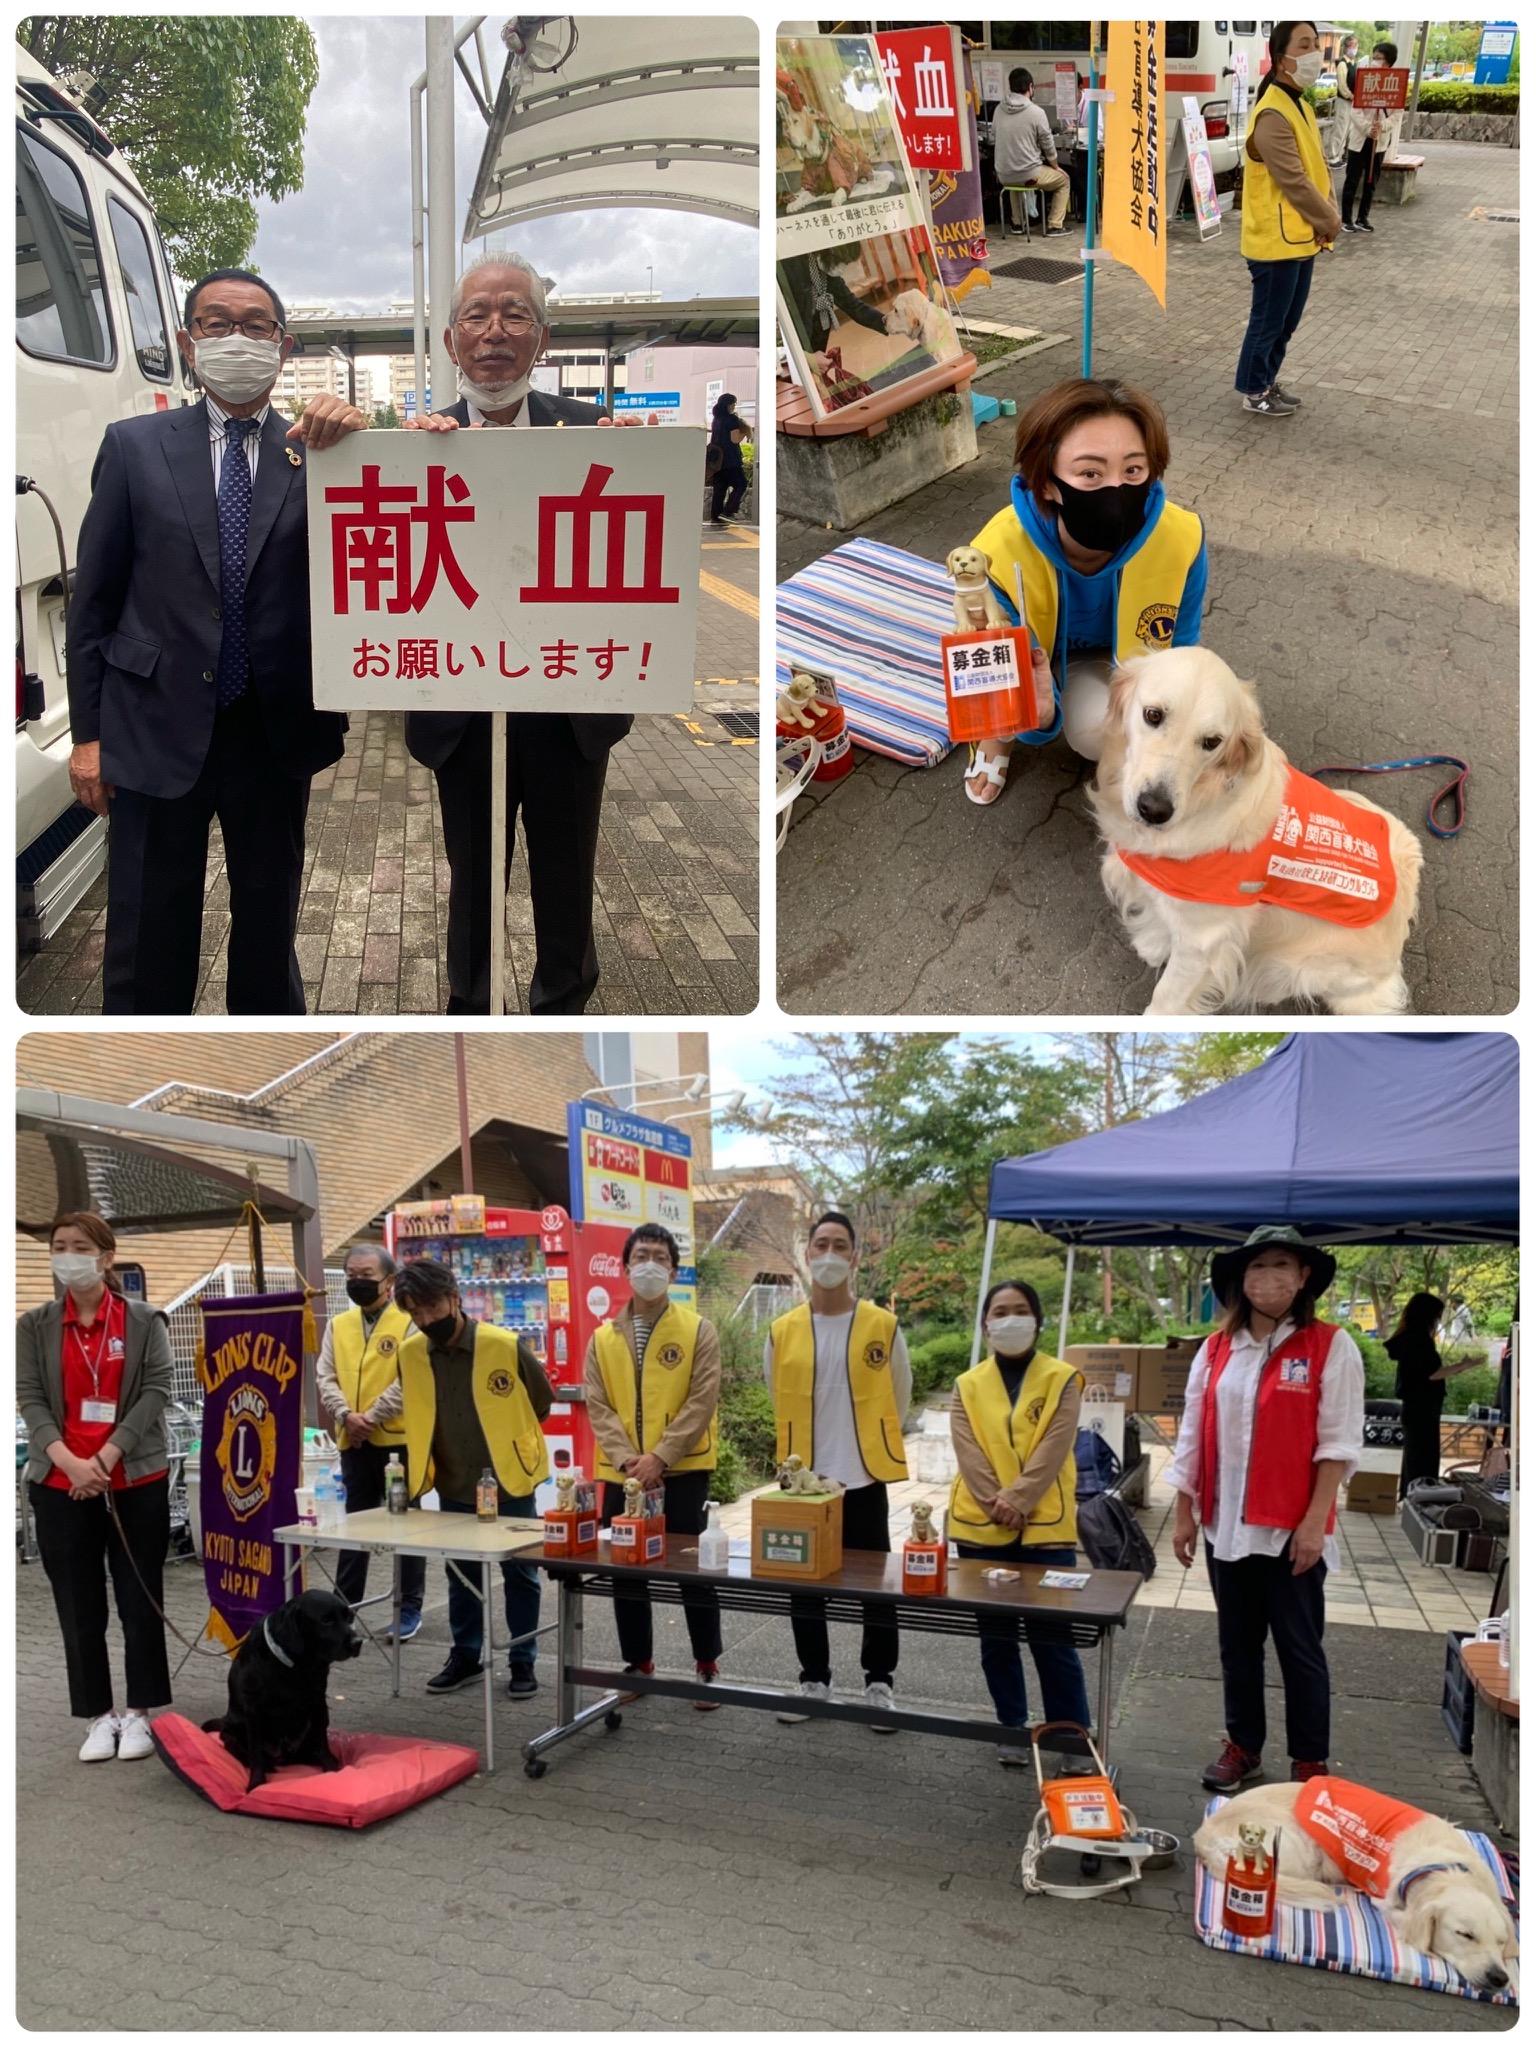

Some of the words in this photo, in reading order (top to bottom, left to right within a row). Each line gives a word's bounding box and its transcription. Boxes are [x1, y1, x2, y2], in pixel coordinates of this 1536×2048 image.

[1362, 72, 1400, 93] 献血
[143, 348, 164, 362] HINO
[408, 392, 415, 403] P
[324, 463, 680, 615] 献血
[1154, 619, 1173, 639] L
[352, 638, 652, 681] お願いします!
[952, 644, 1011, 671] 募金箱
[967, 672, 1015, 686] 関西盲導犬協会
[1304, 823, 1379, 863] 関西盲導犬協会
[204, 1331, 252, 1395] LIONS
[236, 1426, 254, 1478] L
[205, 1531, 235, 1566] KYOTO
[767, 1533, 803, 1546] 募金箱
[907, 1553, 935, 1564] 募金箱
[220, 1568, 260, 1600] JAPAN
[1231, 1887, 1264, 1904] 募金箱
